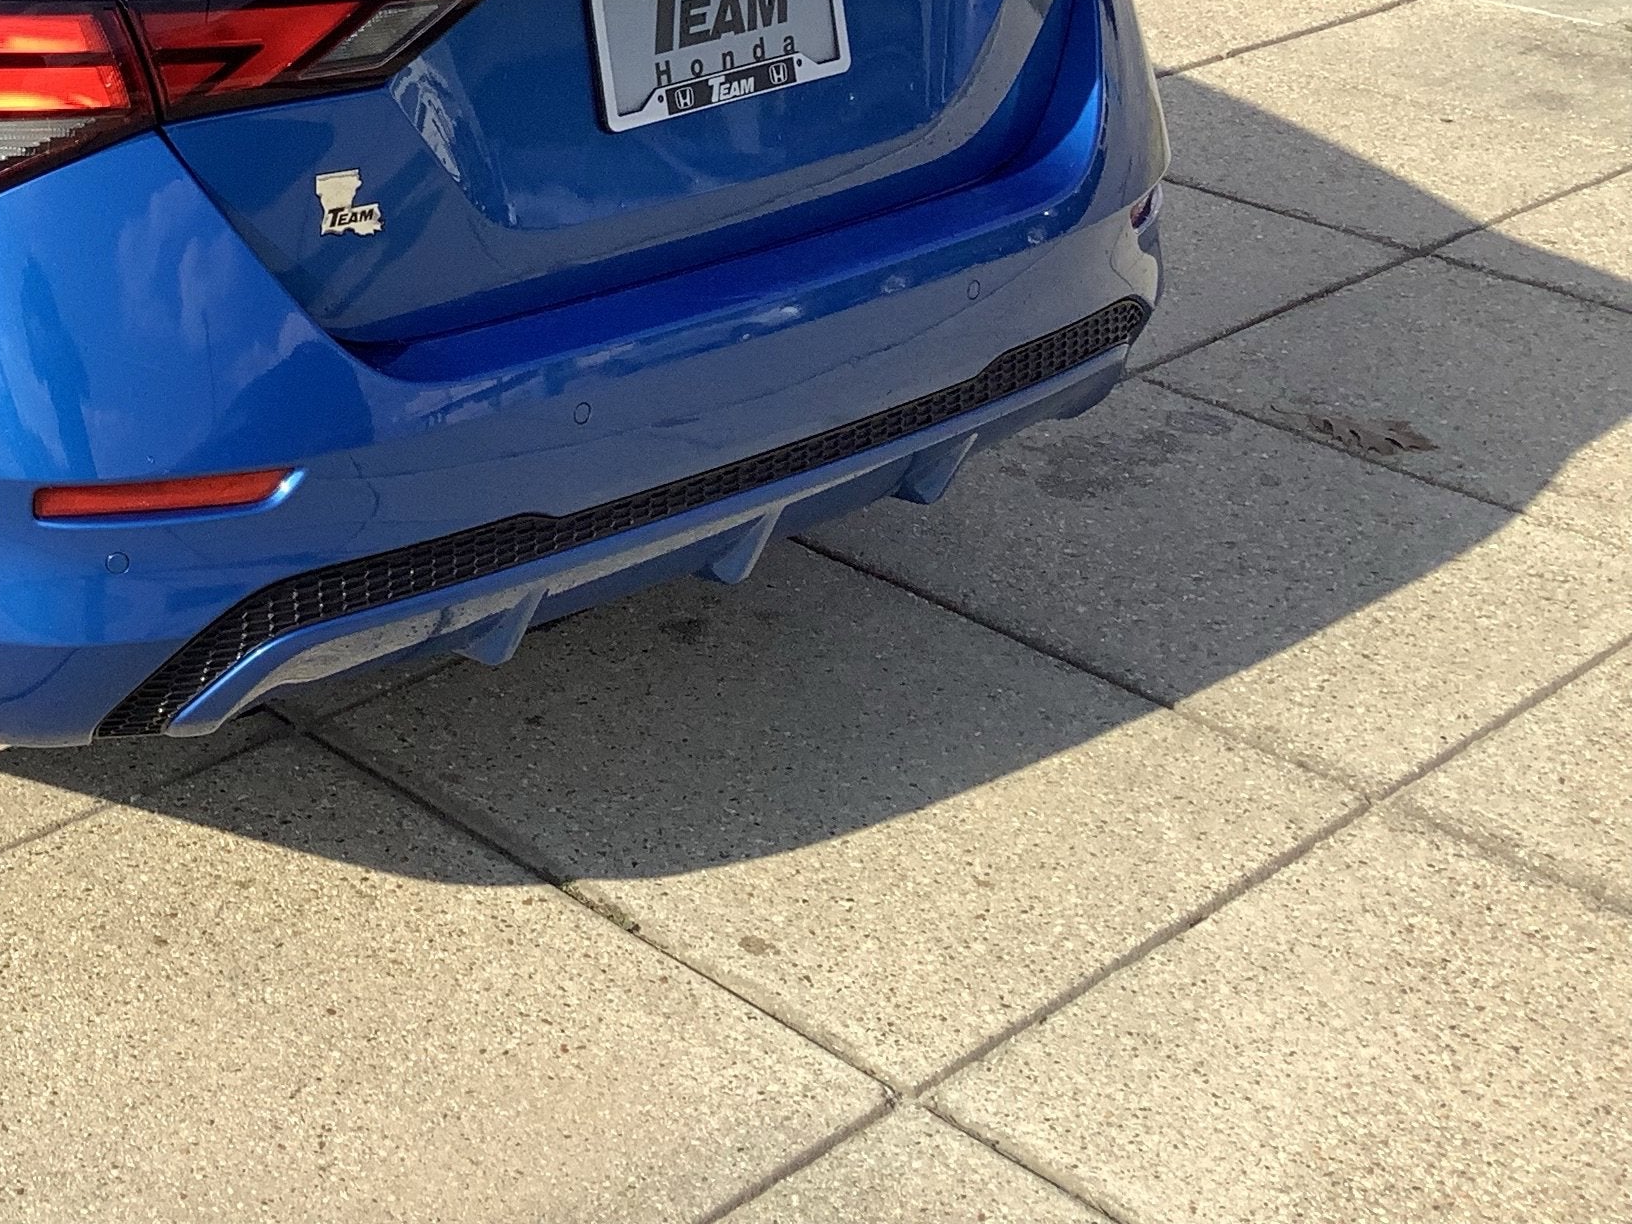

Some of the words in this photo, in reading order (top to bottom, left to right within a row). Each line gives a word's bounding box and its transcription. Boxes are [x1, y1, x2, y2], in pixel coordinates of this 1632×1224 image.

[655, 35, 797, 87] Honda
[708, 76, 755, 103] TEAM
[328, 206, 375, 228] TEAM
